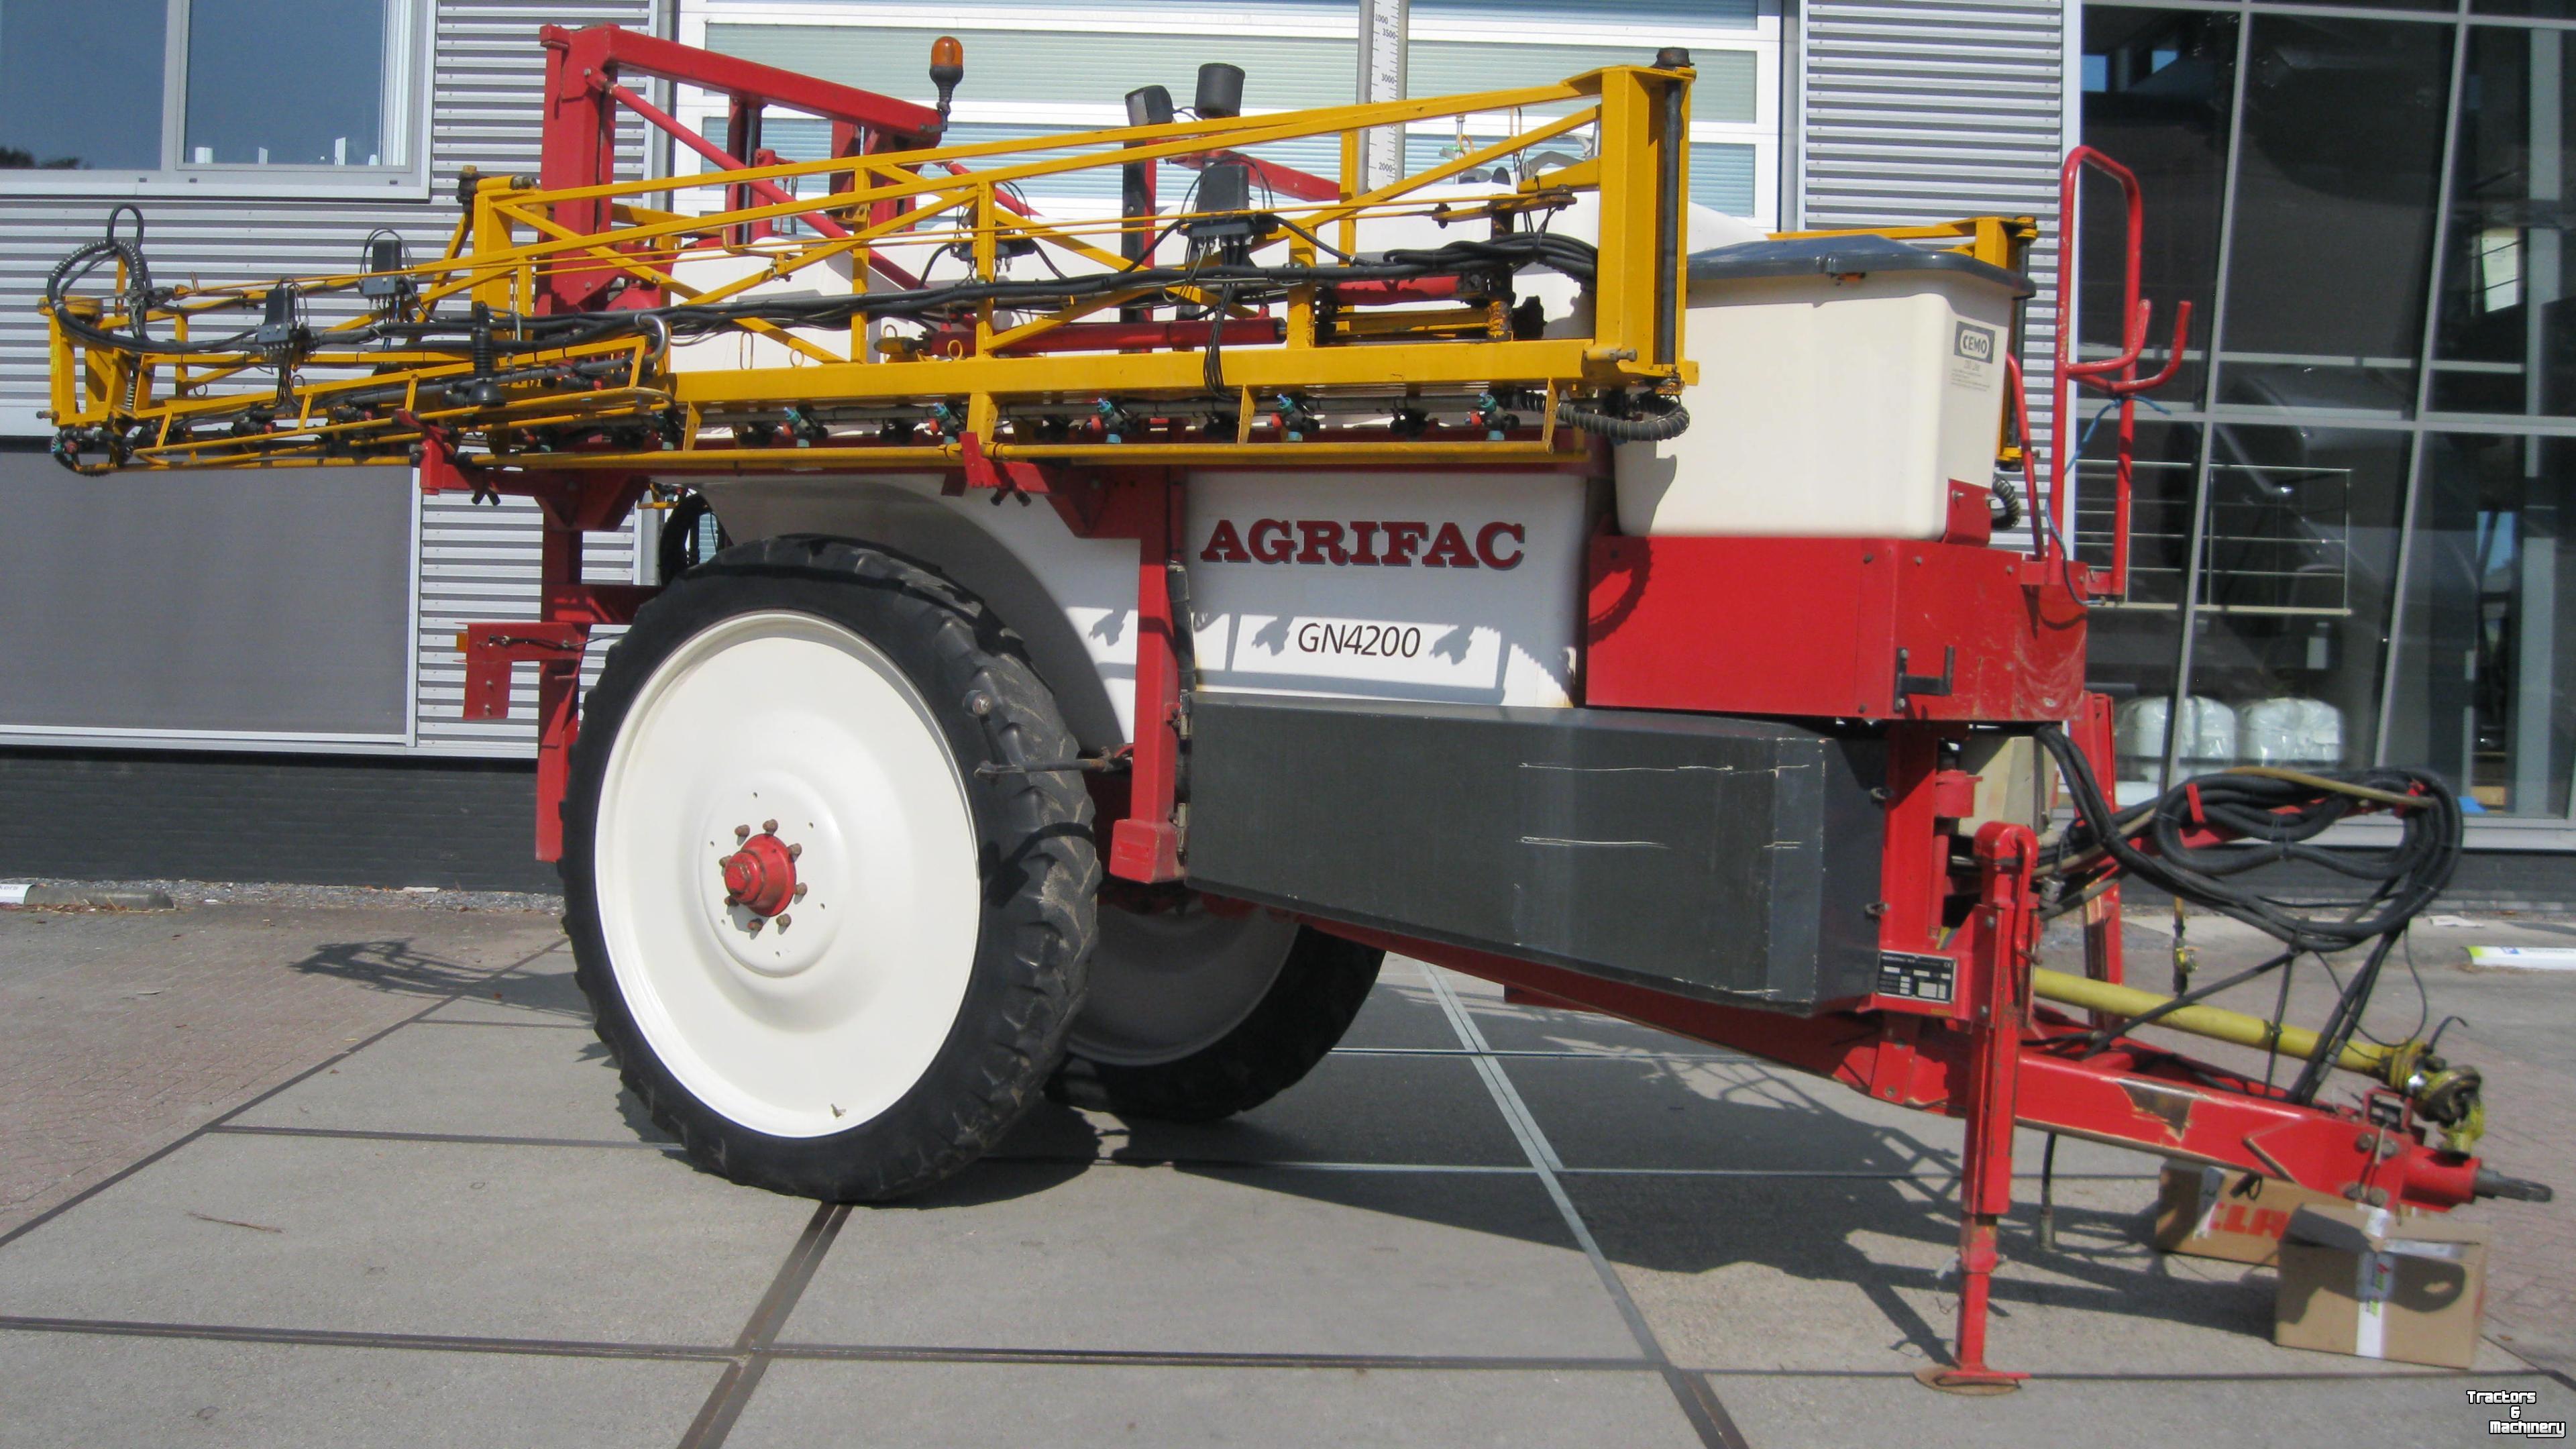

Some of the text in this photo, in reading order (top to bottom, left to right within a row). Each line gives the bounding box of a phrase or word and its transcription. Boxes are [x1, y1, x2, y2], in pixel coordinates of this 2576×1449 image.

[1382, 28, 1396, 40] 3500
[1381, 73, 1395, 85] 3000
[1379, 161, 1393, 172] 2000
[1963, 335, 1988, 354] CEMO
[1199, 519, 1525, 571] AGRIFAC
[1297, 623, 1421, 658] GN4200
[2209, 1201, 2290, 1239] CLA
